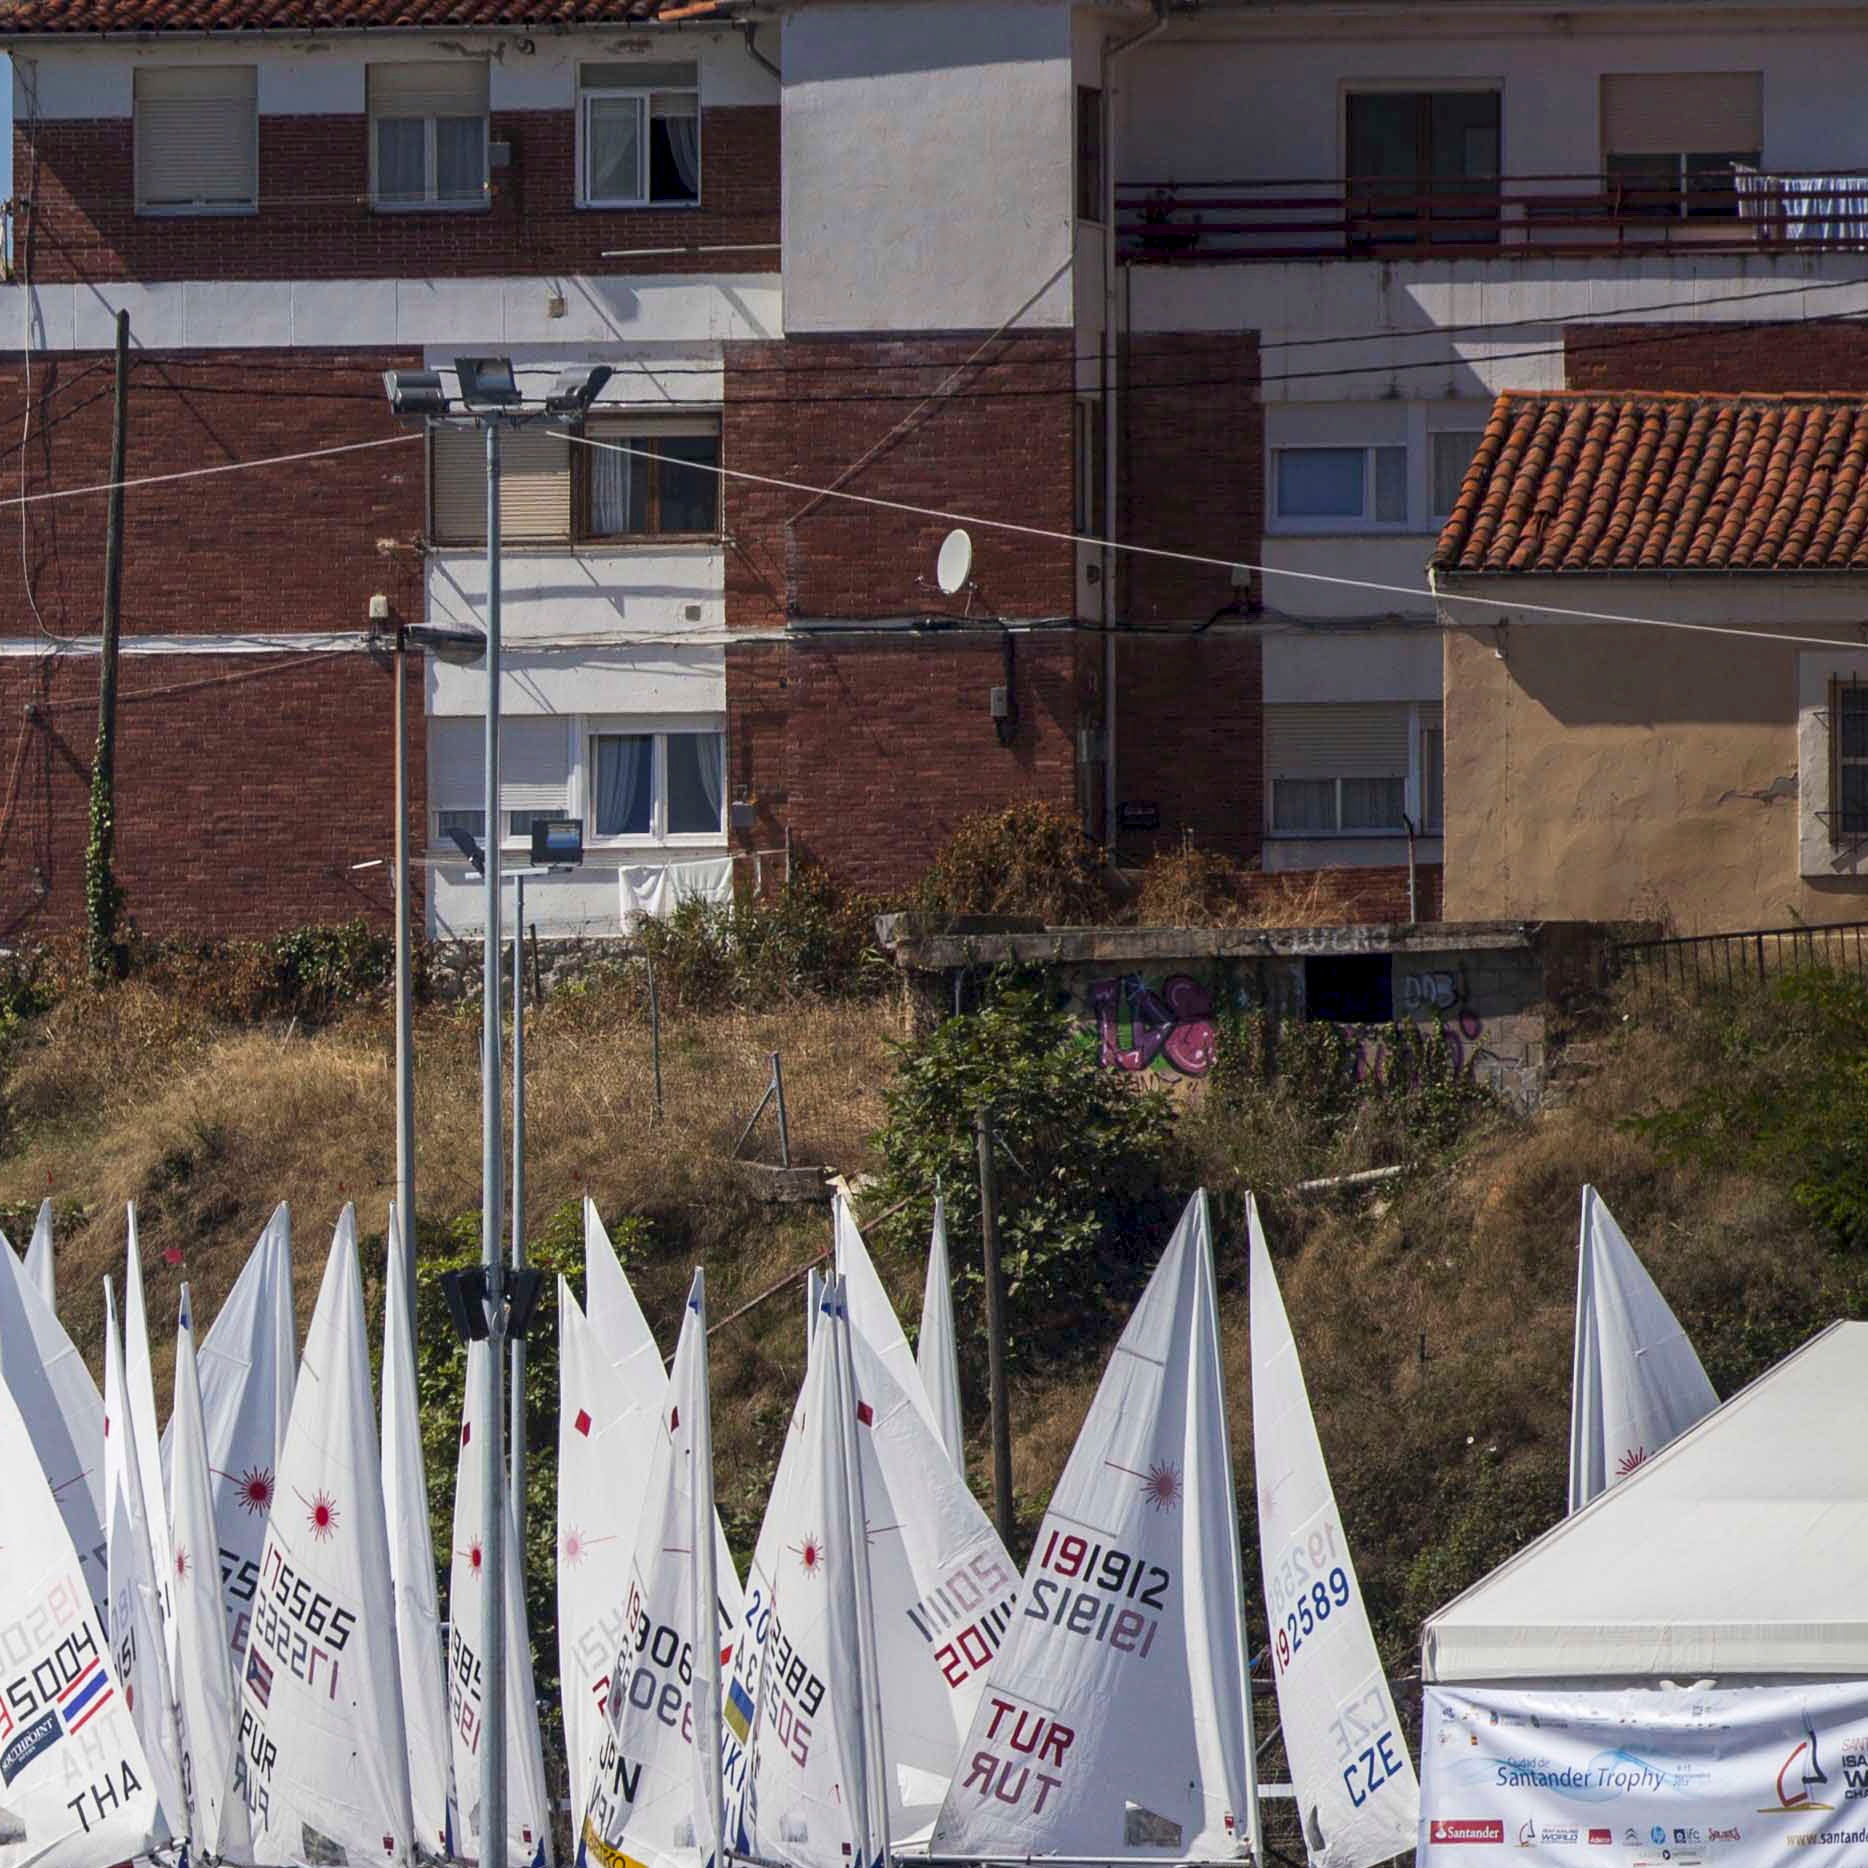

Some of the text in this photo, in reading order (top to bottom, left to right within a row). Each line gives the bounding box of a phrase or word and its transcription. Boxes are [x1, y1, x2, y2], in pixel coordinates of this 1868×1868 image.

[262, 1541, 357, 1652] 175565
[1040, 1530, 1171, 1611] 191912
[934, 1592, 1016, 1689] 20111
[1275, 1567, 1350, 1677] 192589
[238, 1707, 277, 1783] PUR
[986, 1697, 1076, 1768] TUR
[1342, 1730, 1403, 1808] CZE
[66, 1759, 143, 1833] THA
[1495, 1765, 1592, 1787] Santander
[1596, 1766, 1665, 1792] Trophy
[1447, 1825, 1500, 1839] Santander
